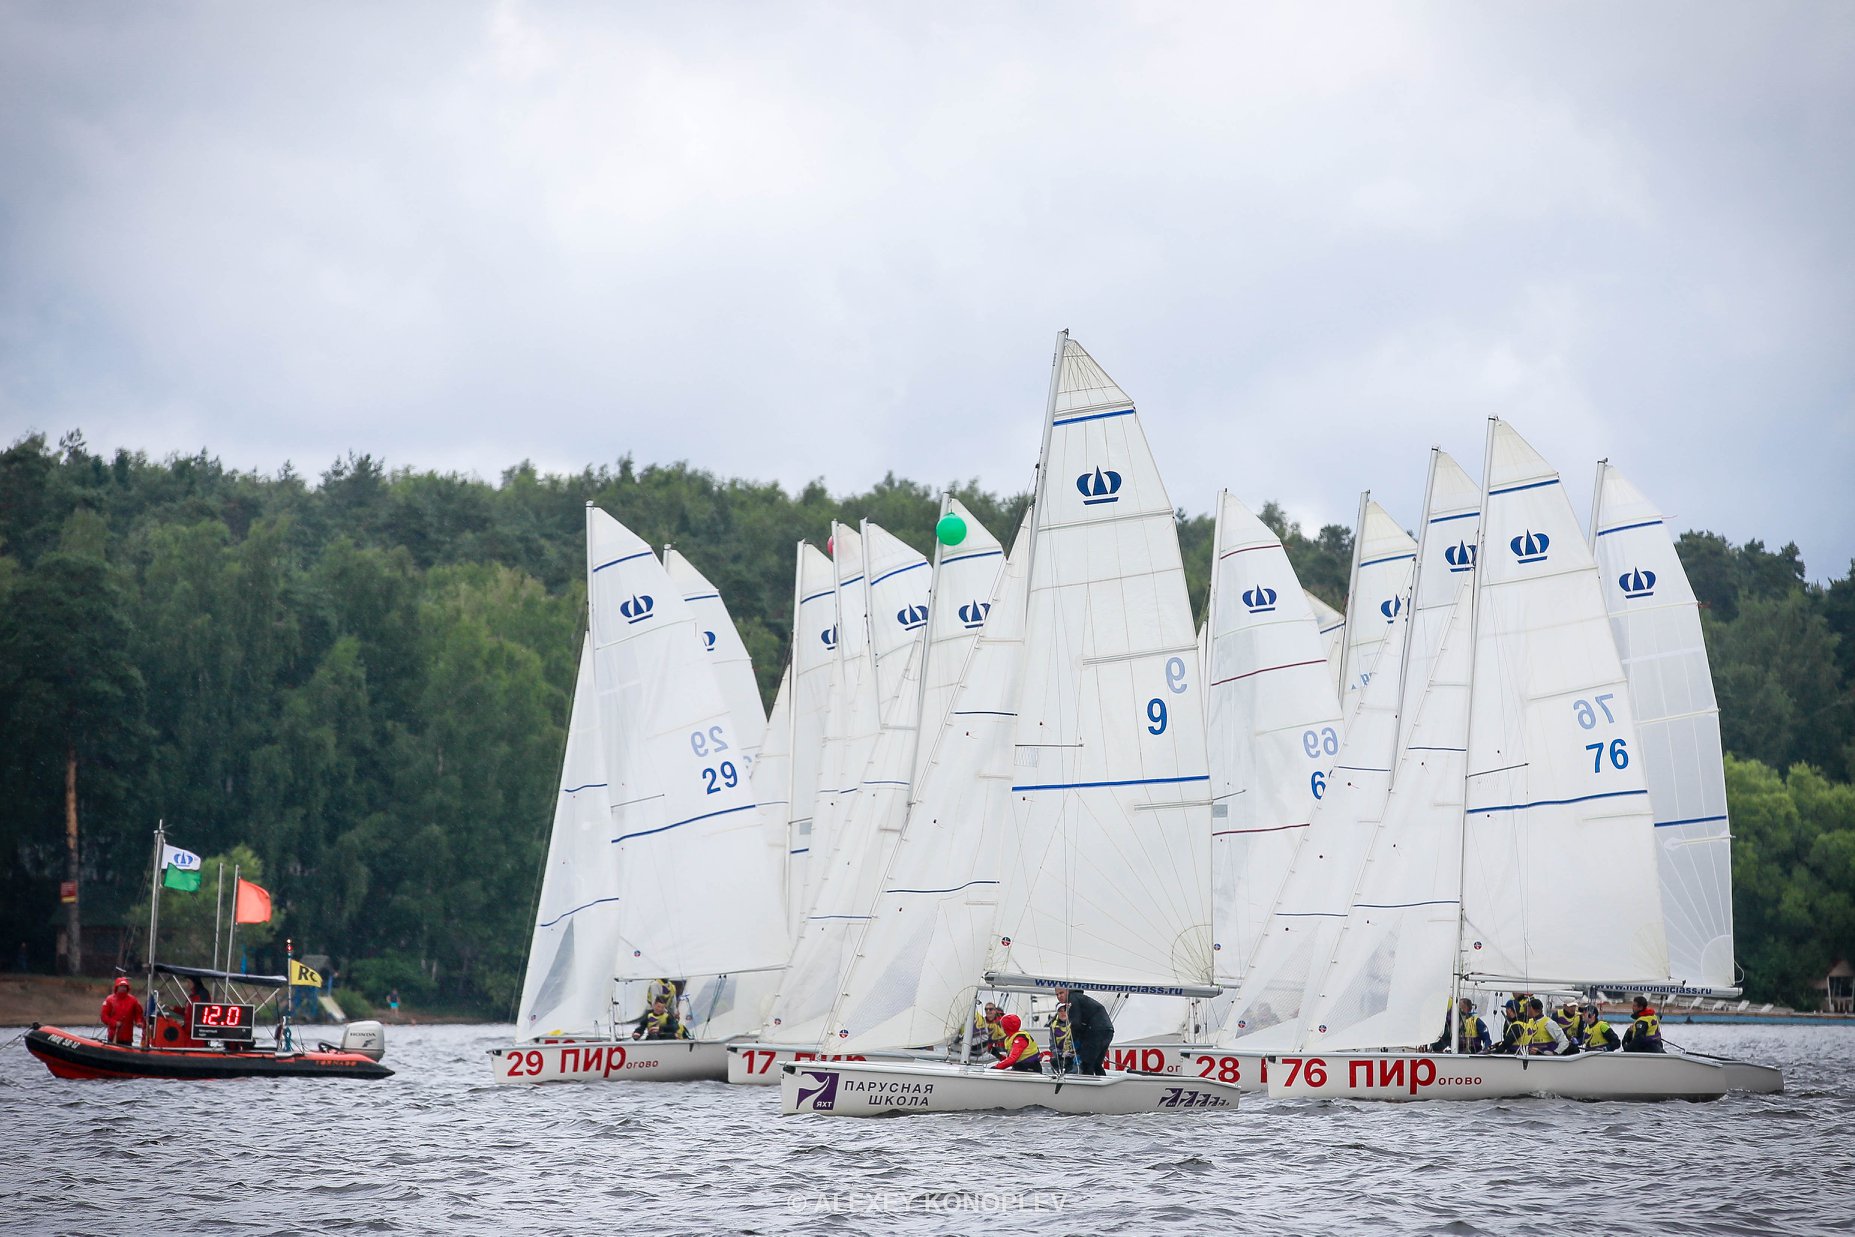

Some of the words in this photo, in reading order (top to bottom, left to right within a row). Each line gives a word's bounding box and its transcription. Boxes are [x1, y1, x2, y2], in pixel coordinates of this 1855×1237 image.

[1147, 698, 1168, 736] 9
[1585, 738, 1629, 774] 76
[702, 760, 738, 795] 29
[1310, 770, 1334, 801] 6
[298, 965, 318, 982] RC
[203, 1005, 241, 1026] 12.0
[507, 1050, 544, 1077] 29
[741, 1050, 777, 1075] 17
[1196, 1055, 1241, 1084] 28
[1281, 1058, 1328, 1088] 76
[844, 1080, 934, 1094] ПАРУСНАЯ
[868, 1094, 929, 1107] ШКОЛА
